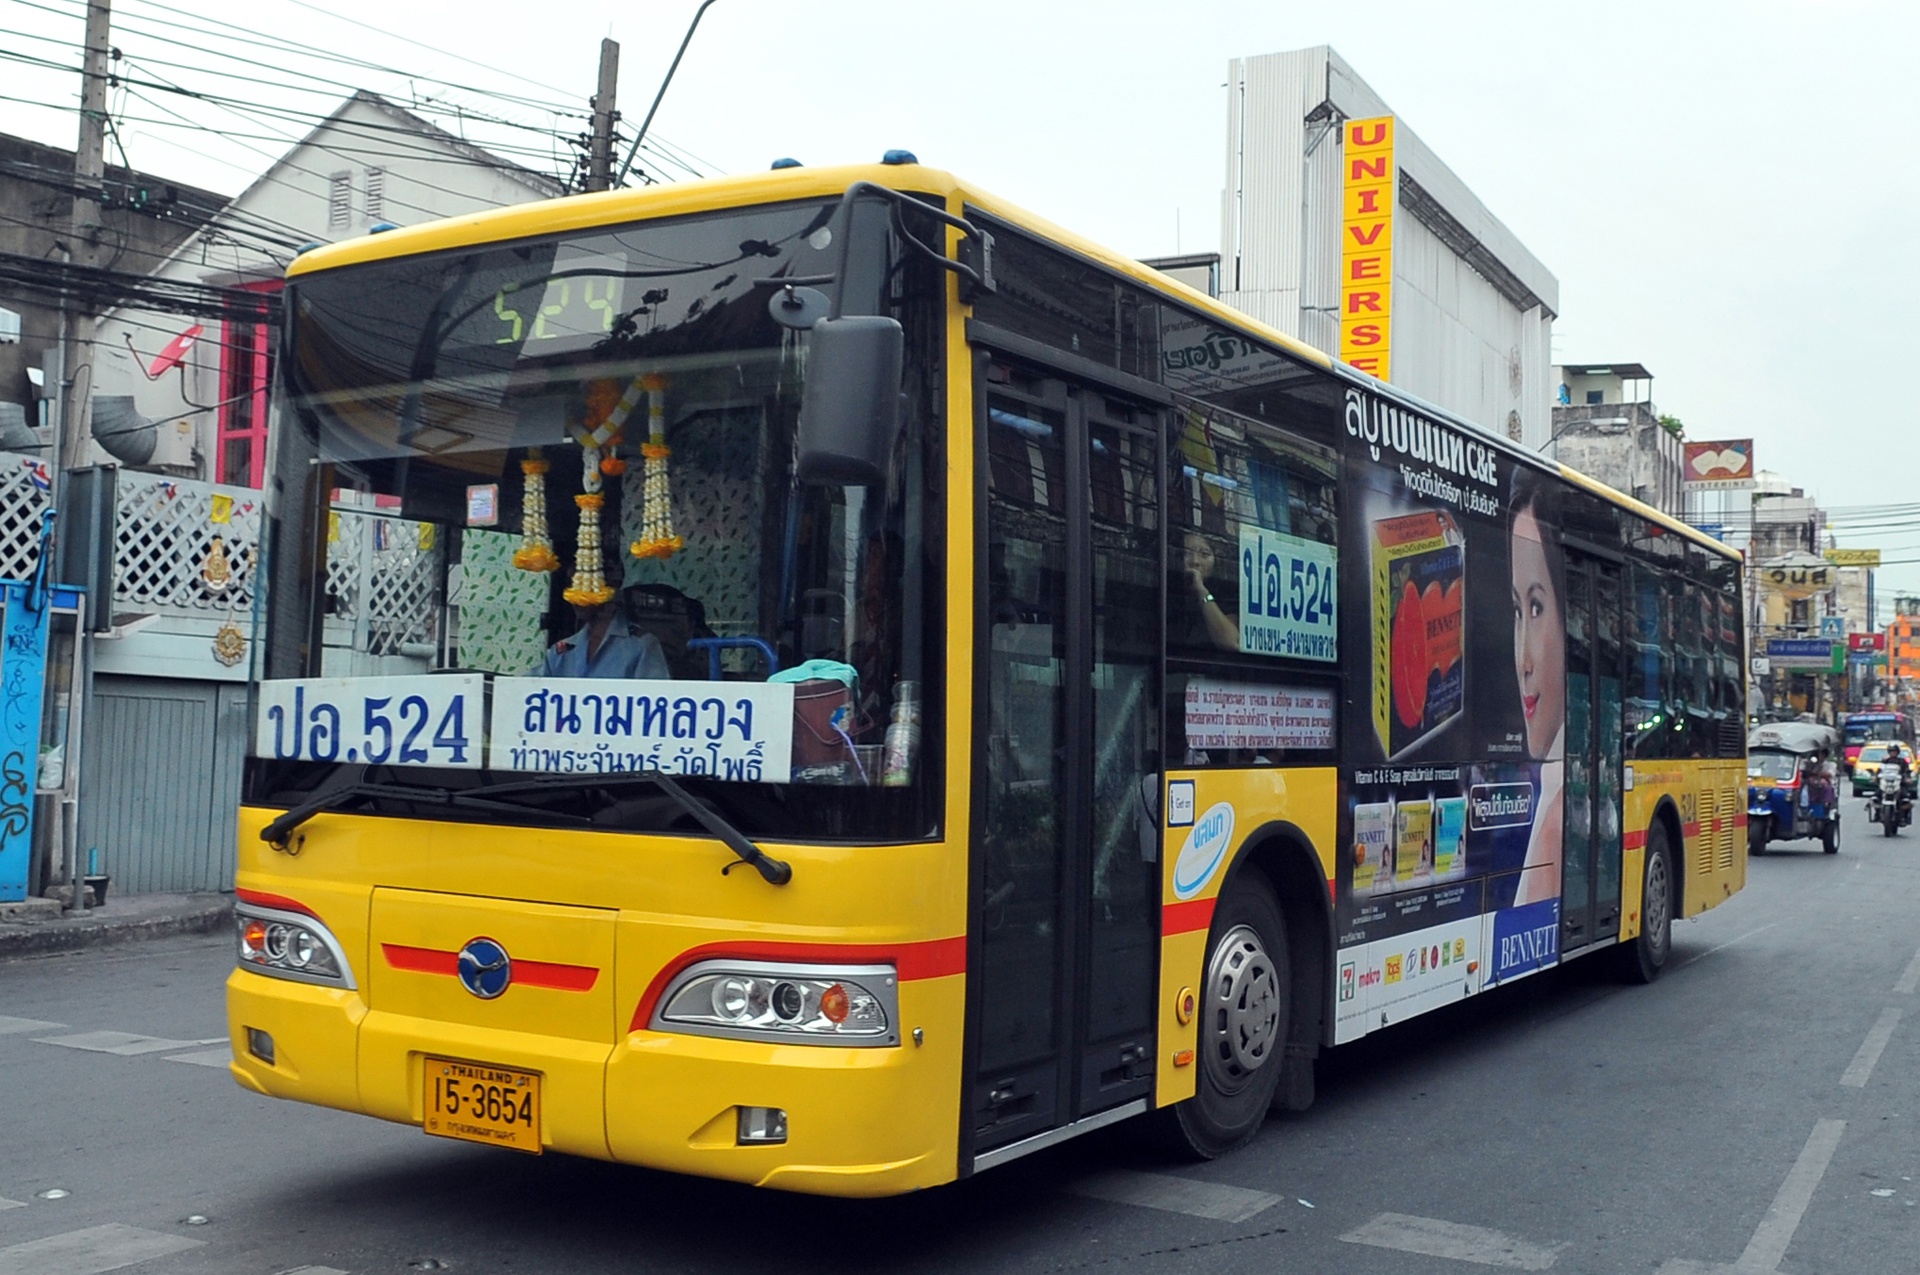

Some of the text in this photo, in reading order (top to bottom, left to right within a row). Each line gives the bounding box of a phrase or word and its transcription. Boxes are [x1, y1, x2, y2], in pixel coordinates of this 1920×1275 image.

[494, 275, 617, 344] 524
[1466, 441, 1498, 487] C&E
[1243, 535, 1333, 626] ปอ.524
[268, 686, 469, 765] ปอ.524
[523, 688, 754, 741] สนามหลวง
[510, 740, 766, 783] ท่าพระจันทร์-วัดโพธิ์
[1500, 923, 1559, 970] BENNETT
[1358, 967, 1381, 988] makro
[450, 1065, 513, 1084] THAILAND
[435, 1076, 532, 1129] 15-3654
